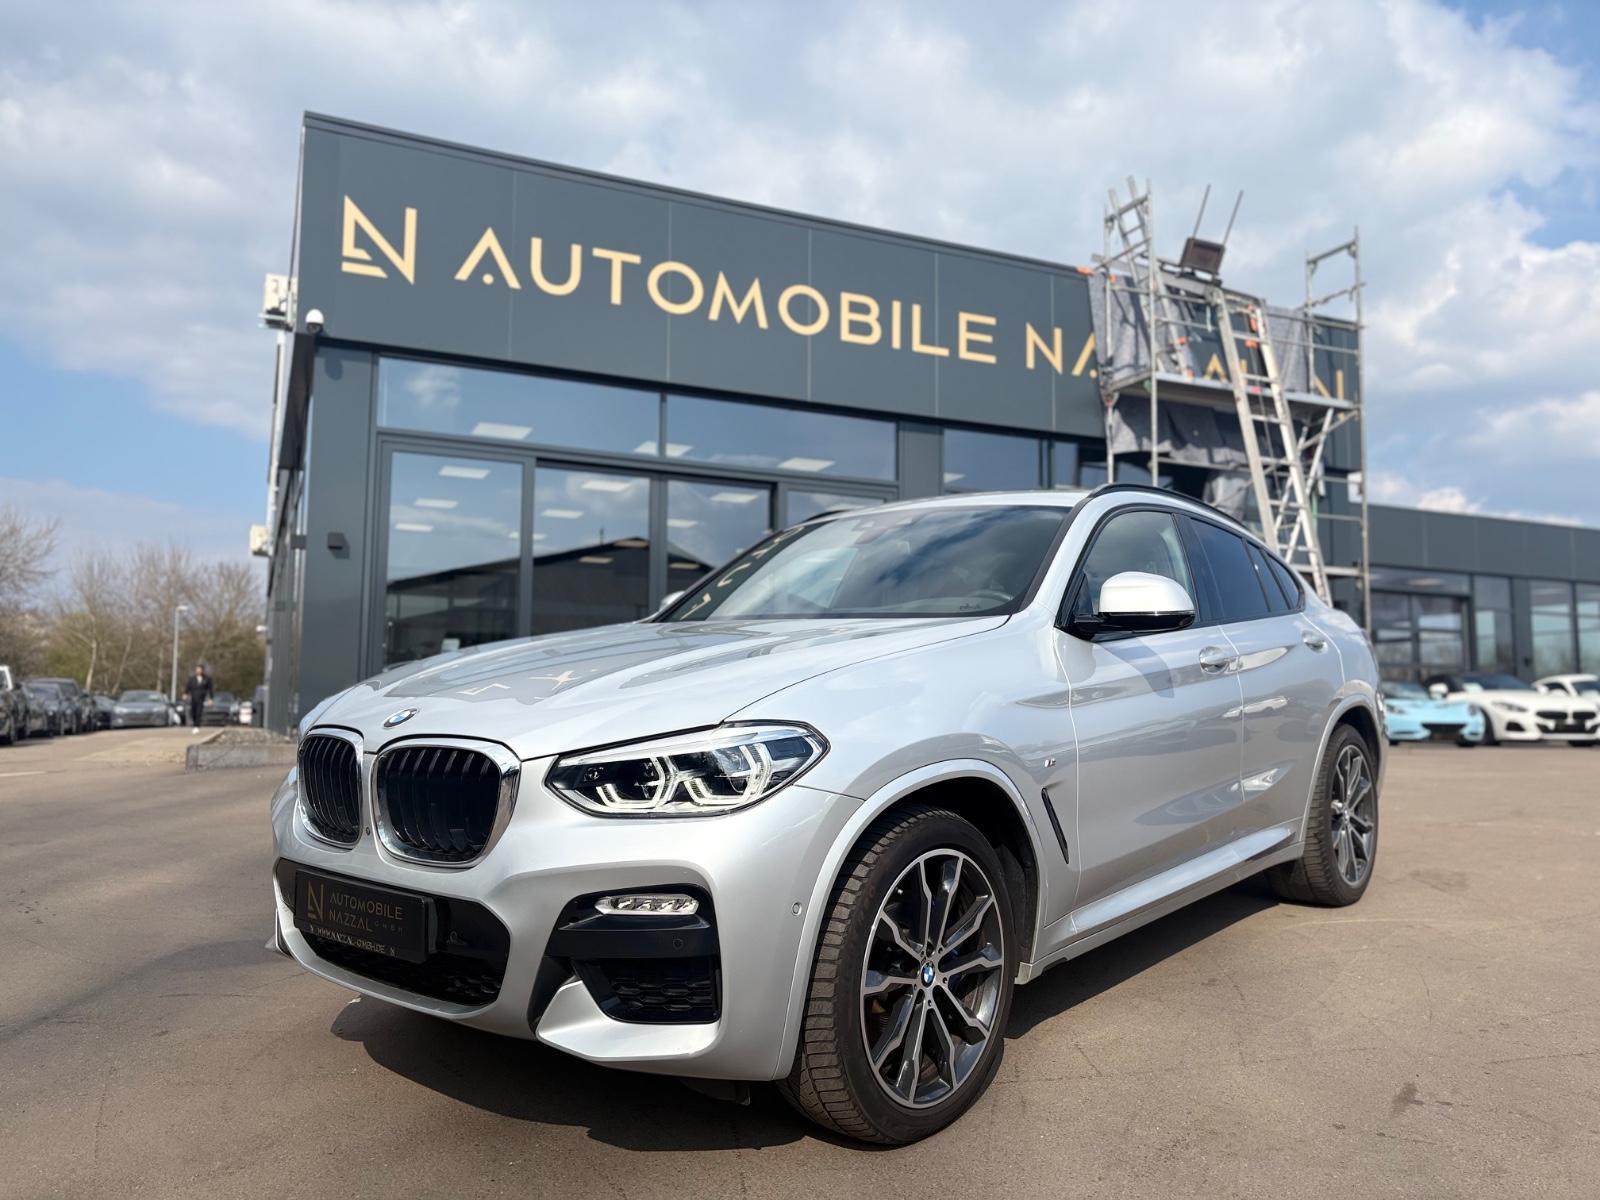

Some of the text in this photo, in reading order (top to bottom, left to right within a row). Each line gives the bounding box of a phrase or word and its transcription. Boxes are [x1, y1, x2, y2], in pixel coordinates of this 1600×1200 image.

[454, 227, 997, 364] AUTOMOBILE
[329, 892, 403, 920] AUTOMOBILE
[329, 909, 373, 932] NAZZAL
